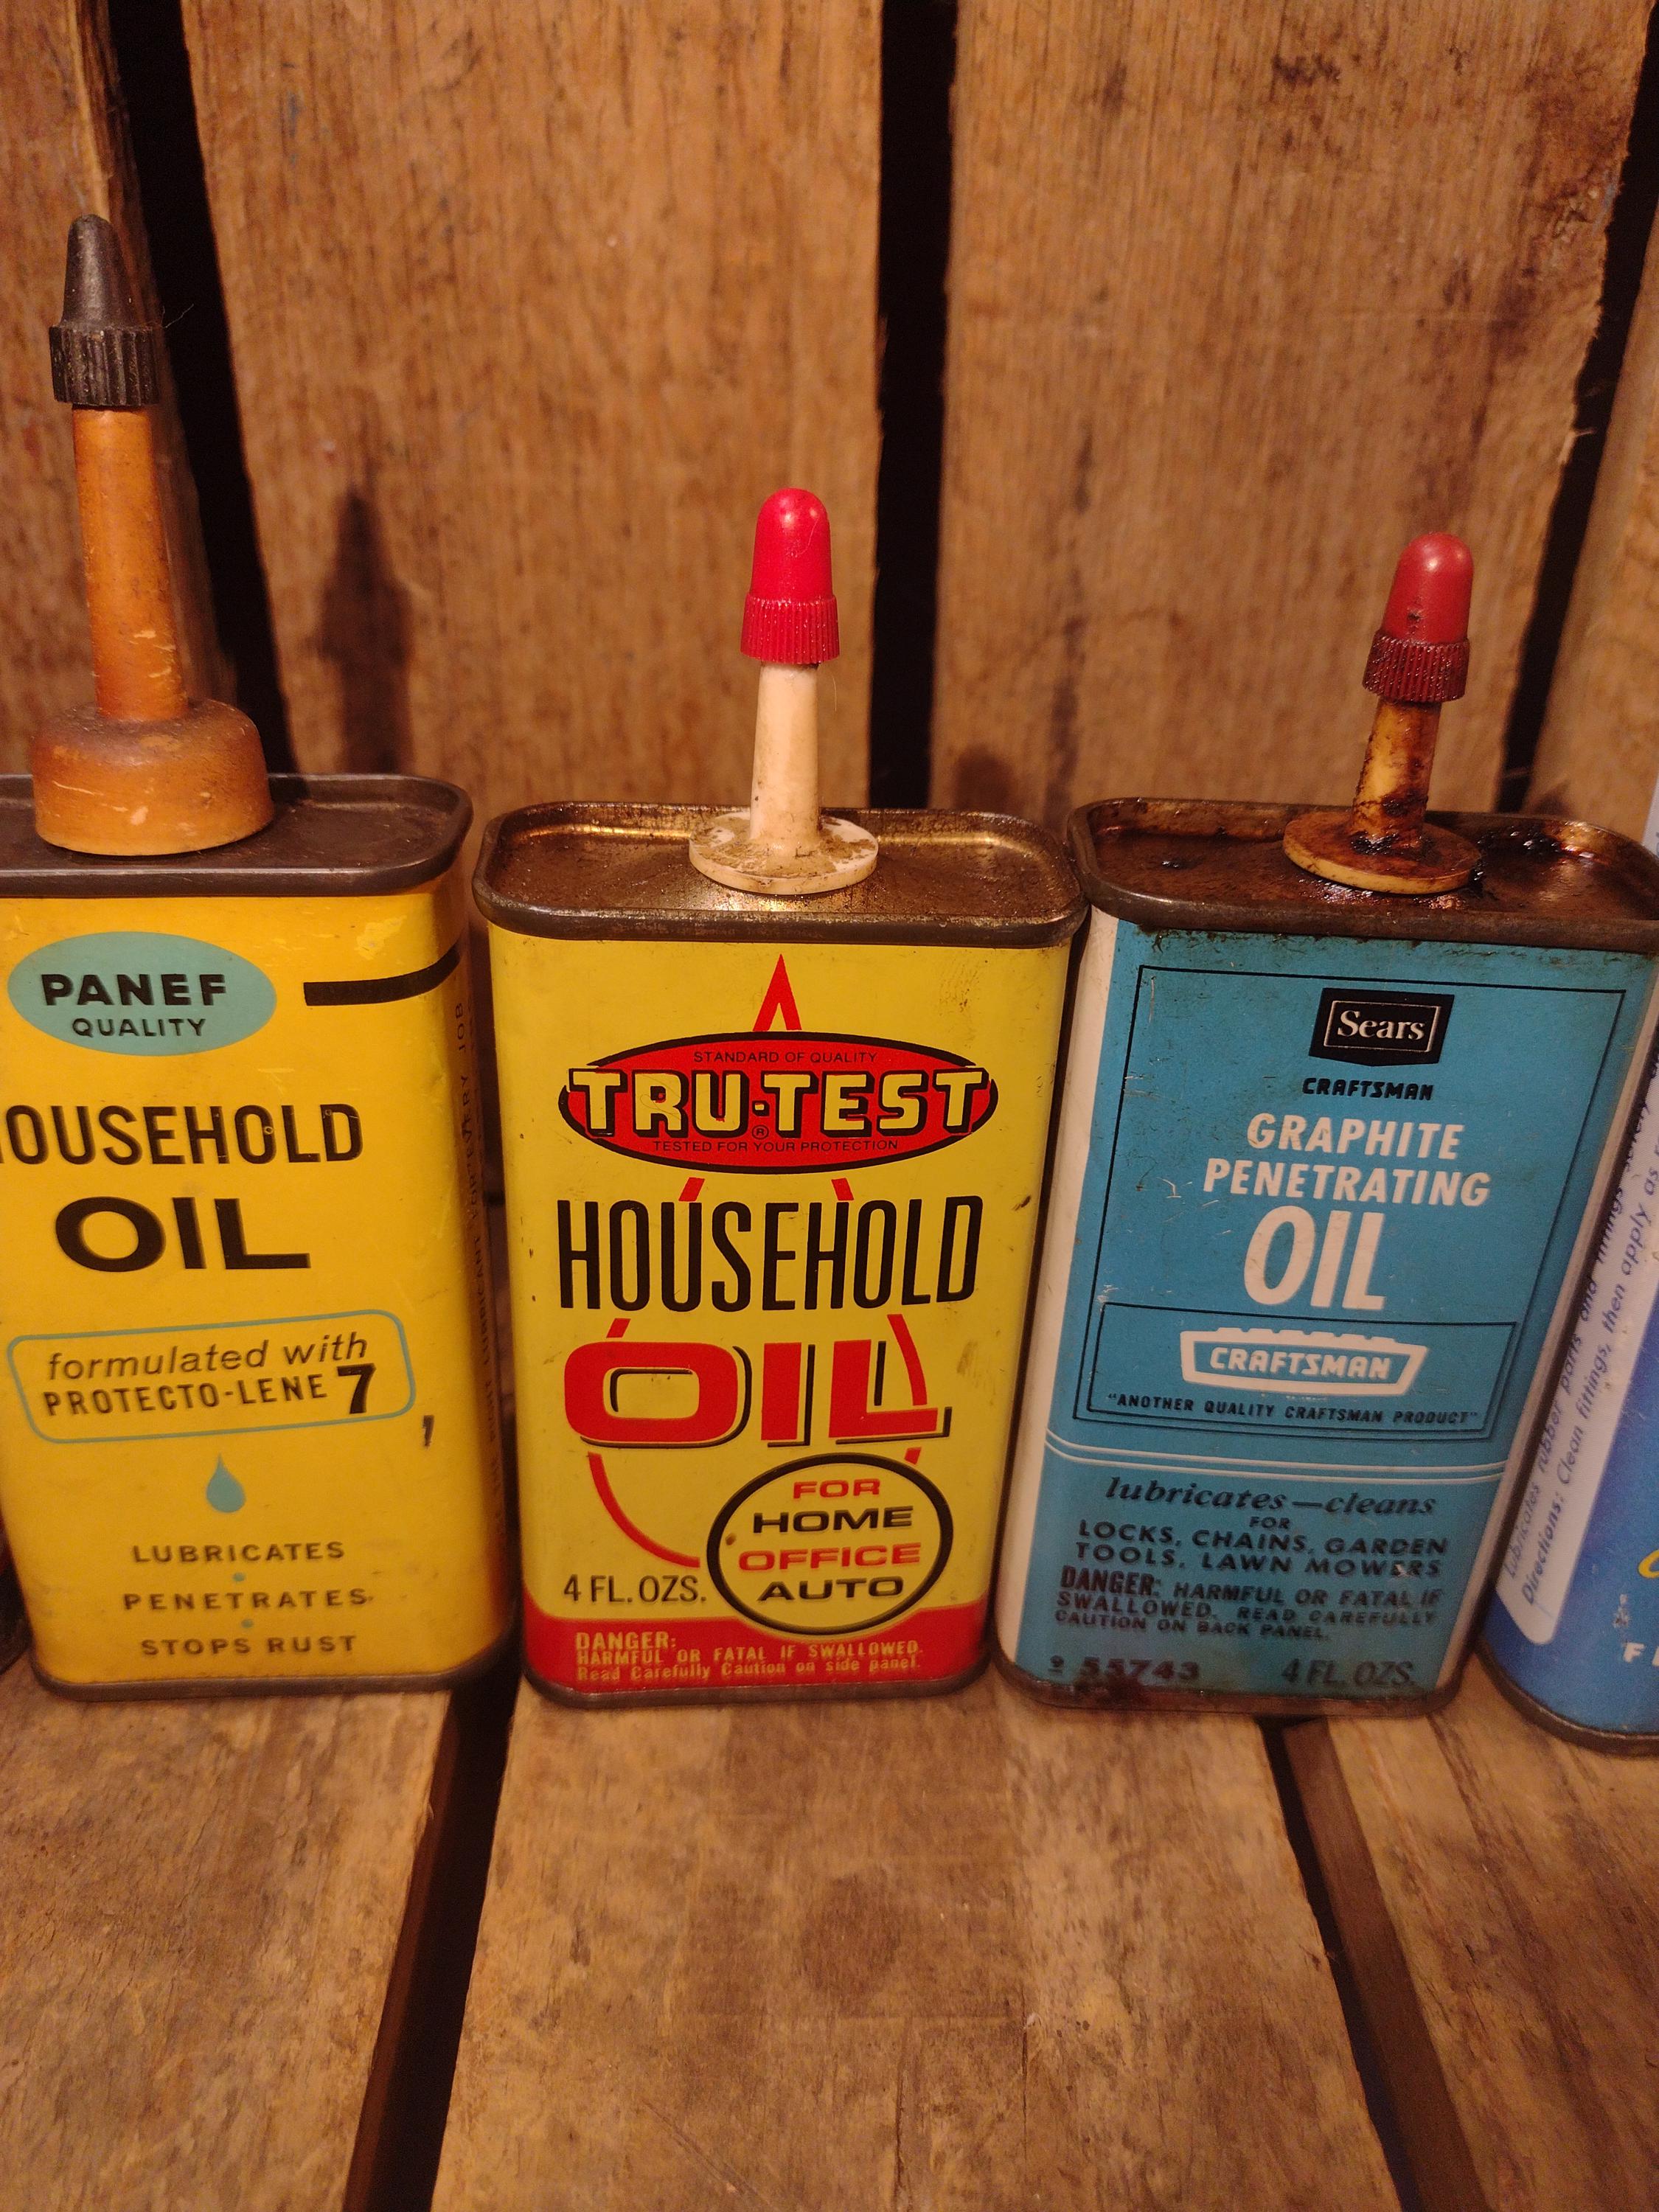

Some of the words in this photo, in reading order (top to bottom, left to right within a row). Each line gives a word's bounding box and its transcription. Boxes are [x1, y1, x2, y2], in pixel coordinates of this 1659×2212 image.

[41, 973, 226, 1006] PANEF
[72, 1018, 207, 1037] QUALITY
[455, 1002, 466, 1052] JOB
[1337, 1009, 1425, 1040] Sears
[693, 1051, 779, 1062] STANDARD
[785, 1051, 805, 1062] OF
[810, 1051, 878, 1063] QUALITY
[1302, 1077, 1434, 1100] CRAFTSMAN
[0, 1103, 364, 1165] OUSEHOLD
[653, 1141, 712, 1152] TESTED
[717, 1141, 748, 1152] FOR
[753, 1141, 796, 1152] YOUR
[800, 1139, 899, 1152] PROTECTION
[1246, 1113, 1466, 1160] GRAPHITE
[1203, 1158, 1491, 1207] PENETRATING
[55, 1195, 311, 1273] OIL
[557, 1195, 984, 1312] HOUSEHOLD
[1243, 1206, 1386, 1310] OIL
[48, 1340, 268, 1381] formulated
[283, 1332, 368, 1363] with
[1209, 1347, 1391, 1380] CRAFTSMAN
[42, 1373, 328, 1417] PROTECTO-LENE
[337, 1363, 375, 1414] 7
[563, 1339, 953, 1449] OIL
[1521, 1491, 1565, 1606] Directions:
[1556, 1425, 1584, 1484] Clean
[1576, 1343, 1613, 1419] fittings,
[1602, 1284, 1627, 1333] then
[1622, 1202, 1652, 1276] apply
[1203, 1400, 1275, 1416] QUALITY
[1284, 1405, 1383, 1424] CRAFTSMAN
[1504, 1481, 1540, 1579] Lubricates
[1538, 1400, 1564, 1474] rubber
[1561, 1335, 1582, 1395] parts
[793, 1478, 881, 1499] FOR
[752, 1506, 914, 1534] HOME
[1249, 1516, 1290, 1529] FOR
[1078, 1520, 1182, 1546] LOCKS,
[1192, 1529, 1314, 1555] CHAINS,
[1324, 1537, 1447, 1554] GARDEN
[133, 1541, 345, 1564] LUBRICATES
[738, 1543, 922, 1571] OFFICE
[1200, 1553, 1291, 1572] LAWN
[1304, 1559, 1441, 1577] MOWERS
[757, 1576, 905, 1601] AUTO
[1060, 1565, 1161, 1596] DANGER:
[1173, 1582, 1284, 1604] HARMFUL
[1295, 1588, 1327, 1604] OR
[1338, 1590, 1411, 1606] FATAL
[1420, 1588, 1441, 1604] IF
[1054, 1610, 1146, 1629] CAUTION
[1157, 1618, 1186, 1632] ON
[1197, 1621, 1249, 1635] BACK
[1237, 1606, 1295, 1621] READ
[1308, 1610, 1436, 1624] CAREFULLY
[140, 1638, 251, 1657] STOPS
[268, 1635, 357, 1654] RUST
[575, 1631, 676, 1650] DANGER:
[577, 1649, 664, 1666] HARMFUL
[676, 1648, 700, 1663] OR
[713, 1646, 767, 1661] FATAL
[780, 1644, 796, 1659] IF
[577, 1664, 620, 1681] Read
[630, 1662, 712, 1680] Carefully
[721, 1659, 785, 1677] Caution
[796, 1660, 815, 1673] on
[825, 1656, 861, 1672] side
